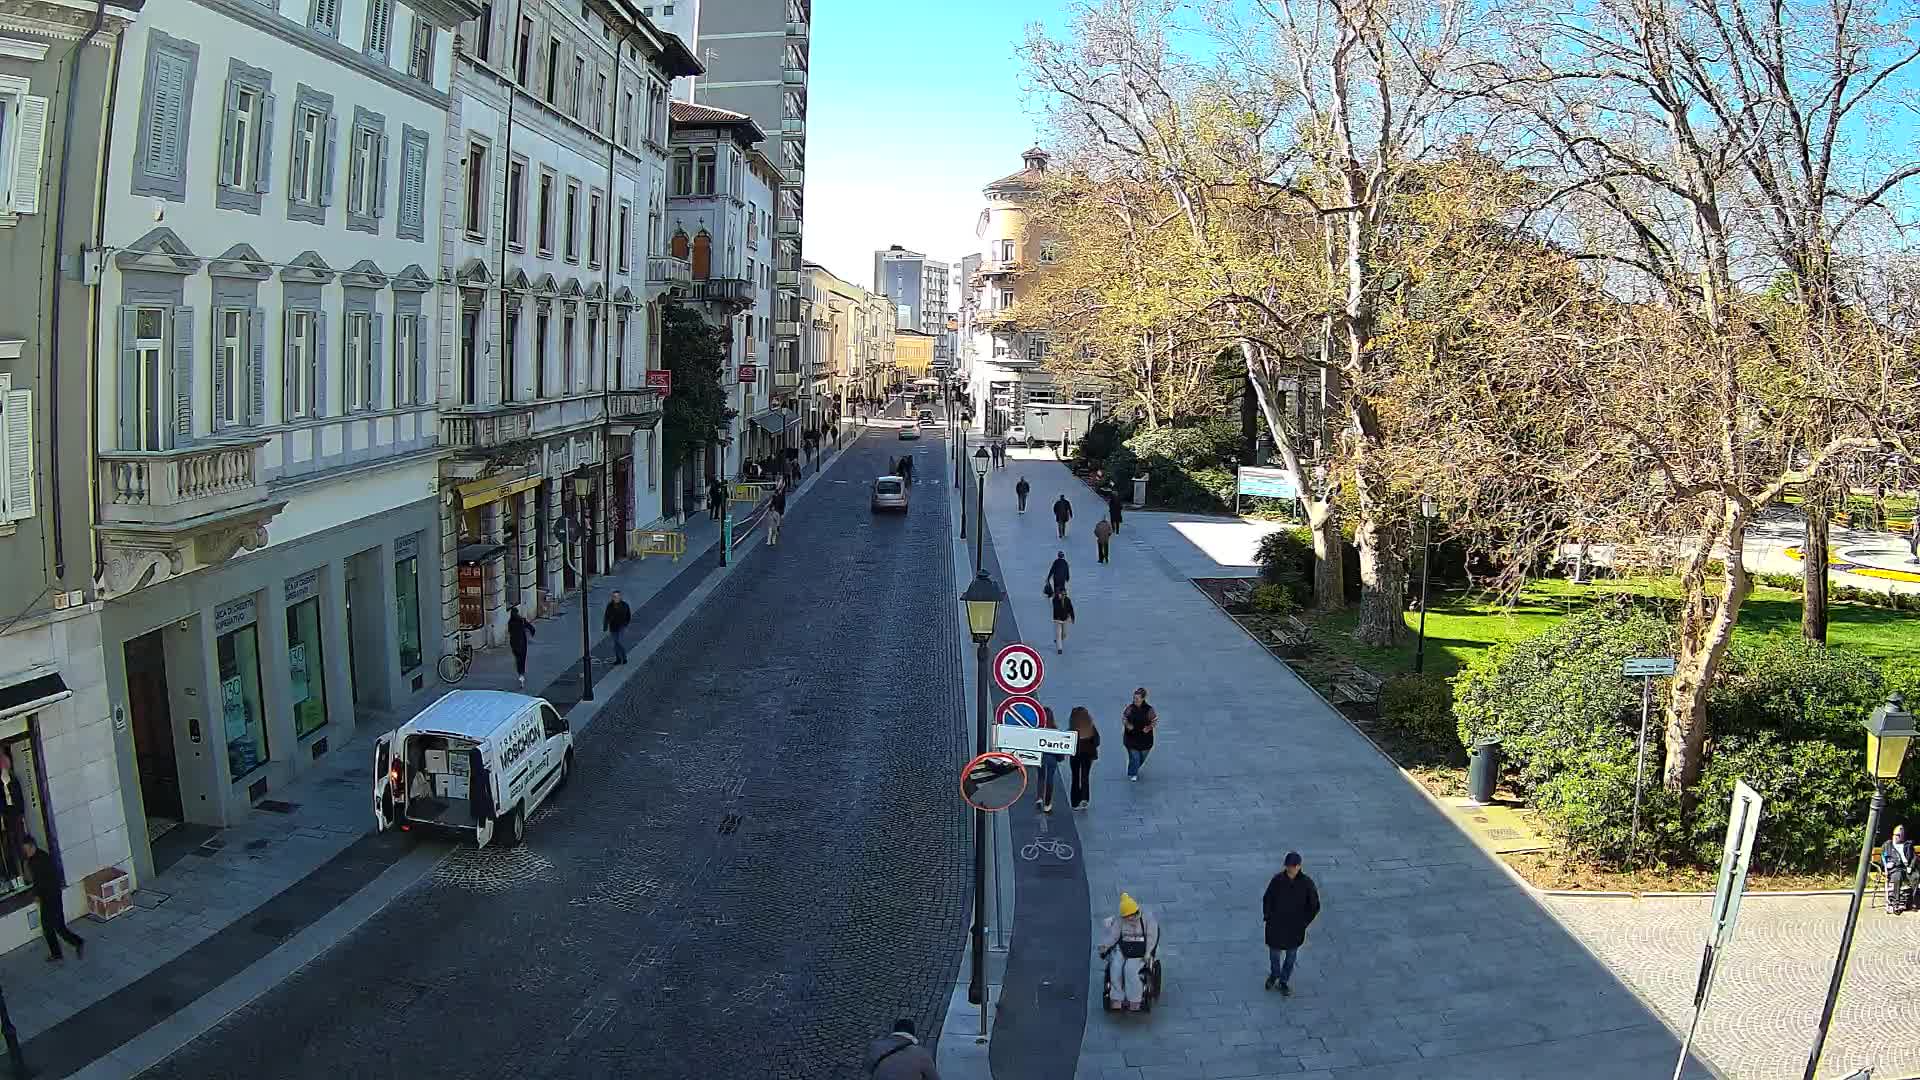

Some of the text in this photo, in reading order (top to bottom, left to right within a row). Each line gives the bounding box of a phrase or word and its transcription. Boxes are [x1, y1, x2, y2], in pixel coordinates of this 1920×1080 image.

[1006, 659, 1033, 680] 30
[500, 725, 541, 771] MOSCHION
[1039, 738, 1070, 749] Dante
